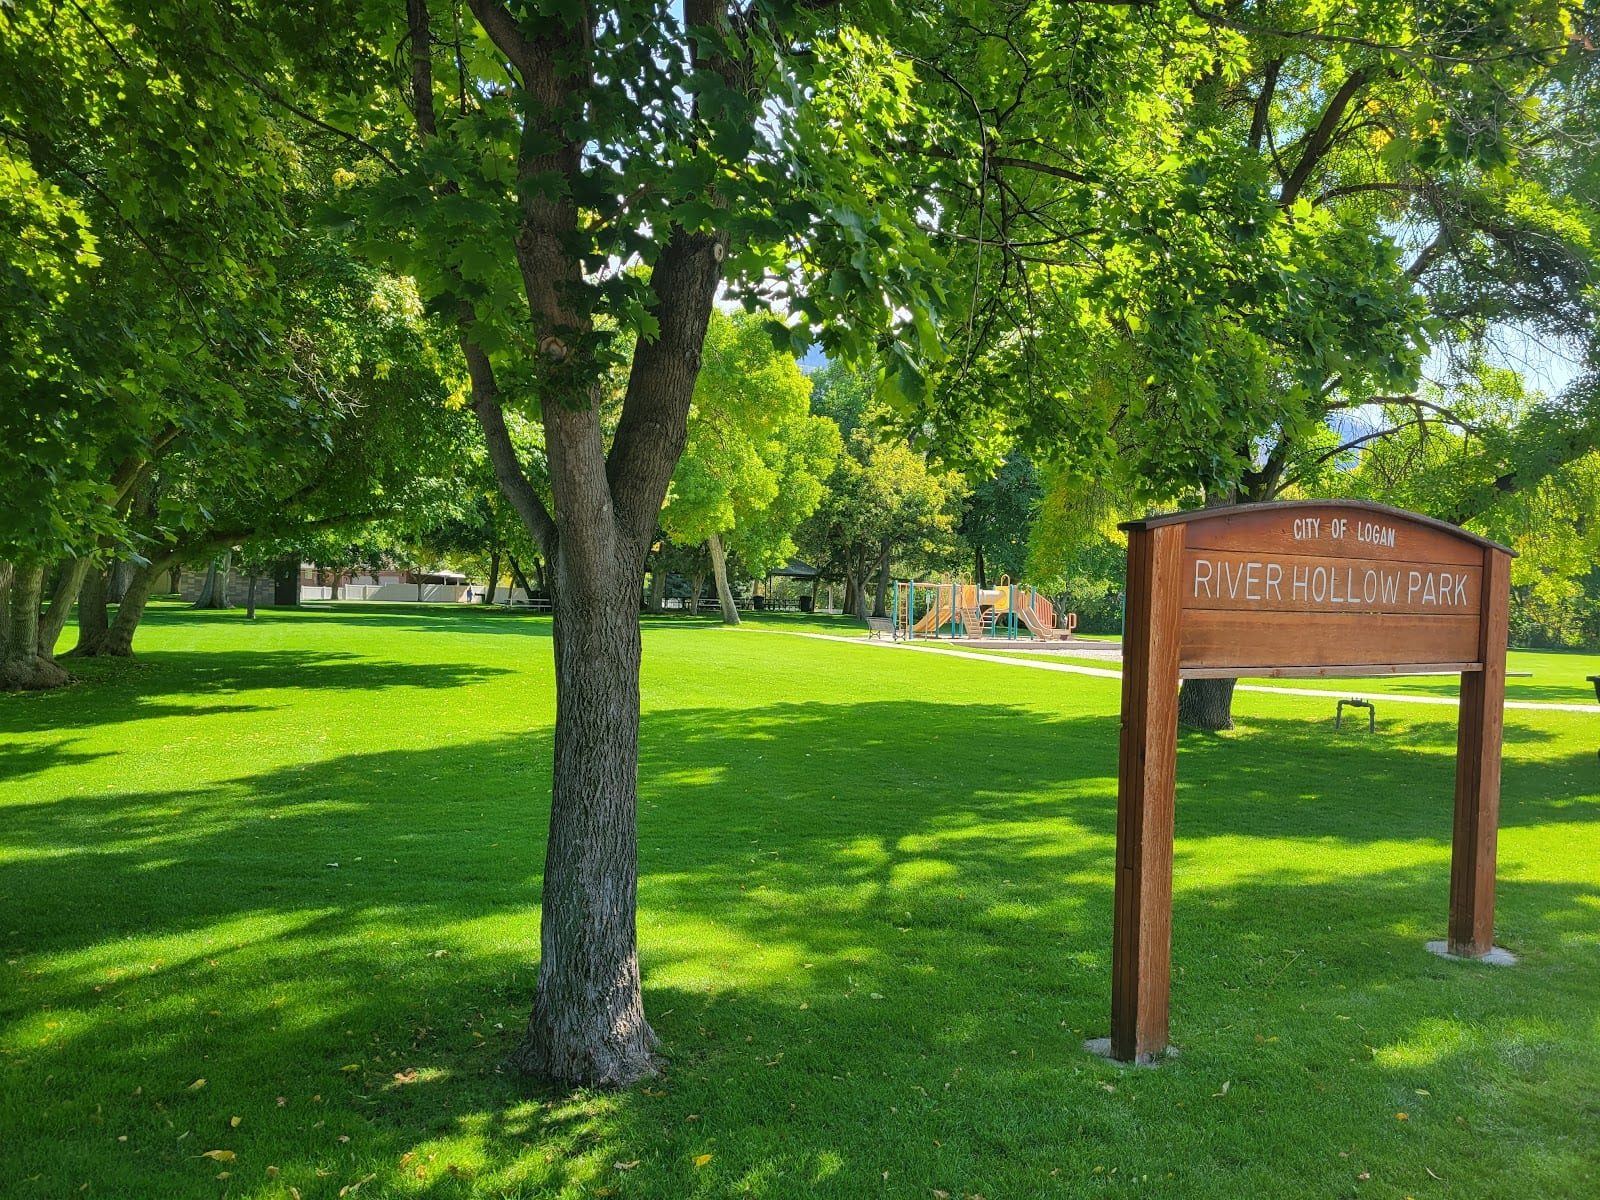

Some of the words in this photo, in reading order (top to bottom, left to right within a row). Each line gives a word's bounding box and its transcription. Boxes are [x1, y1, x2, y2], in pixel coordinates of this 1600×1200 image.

[1293, 518, 1321, 541] CITY
[1331, 518, 1348, 540] OF
[1358, 521, 1395, 548] LOGAN
[1194, 560, 1283, 600] RIVER
[1293, 566, 1401, 604] HOLLOW
[1408, 571, 1467, 606] PARK
